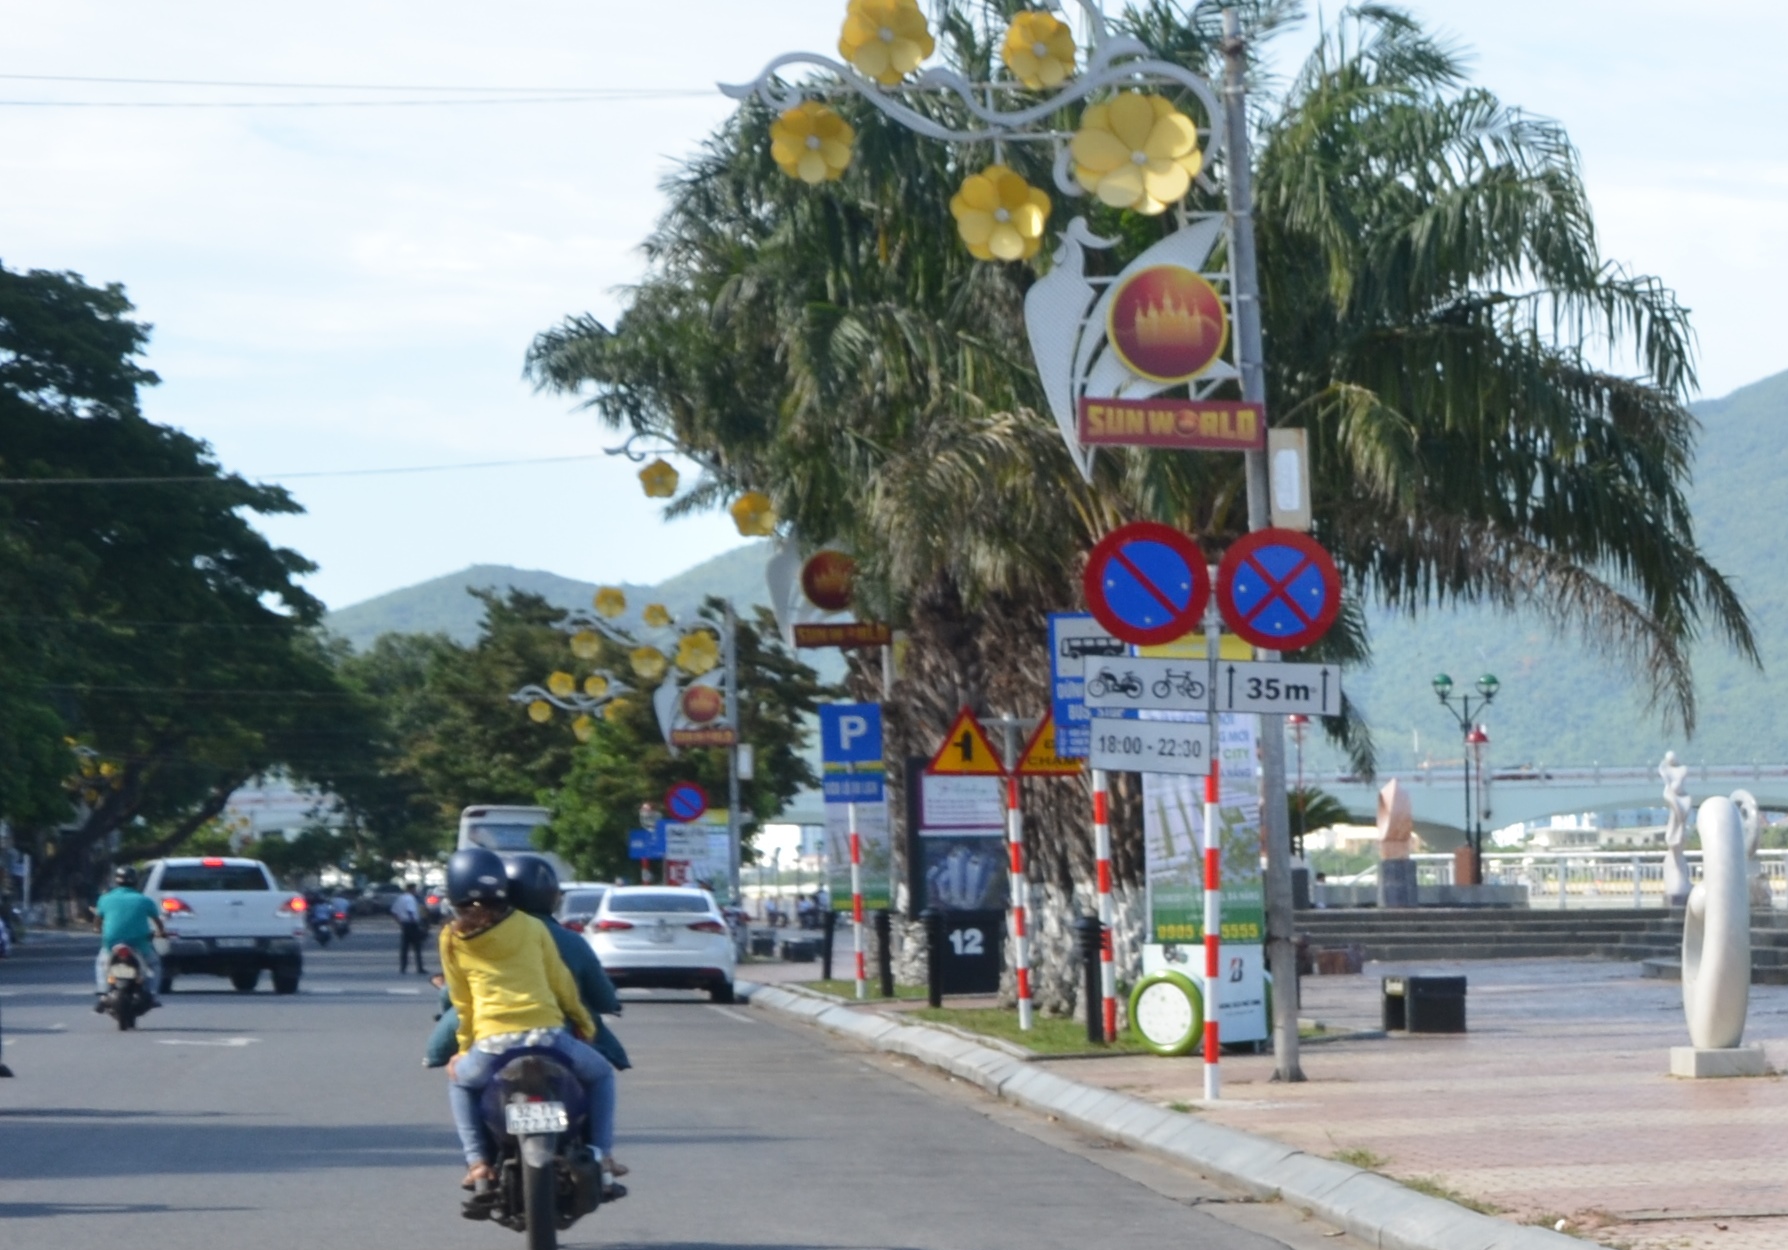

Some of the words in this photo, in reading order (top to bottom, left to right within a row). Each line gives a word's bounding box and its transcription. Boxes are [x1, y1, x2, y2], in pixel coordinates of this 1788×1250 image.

[1087, 404, 1145, 437] SUN
[838, 715, 867, 750] P
[1099, 735, 1142, 755] 18:00
[1158, 738, 1202, 758] 22:30
[949, 927, 984, 955] 12
